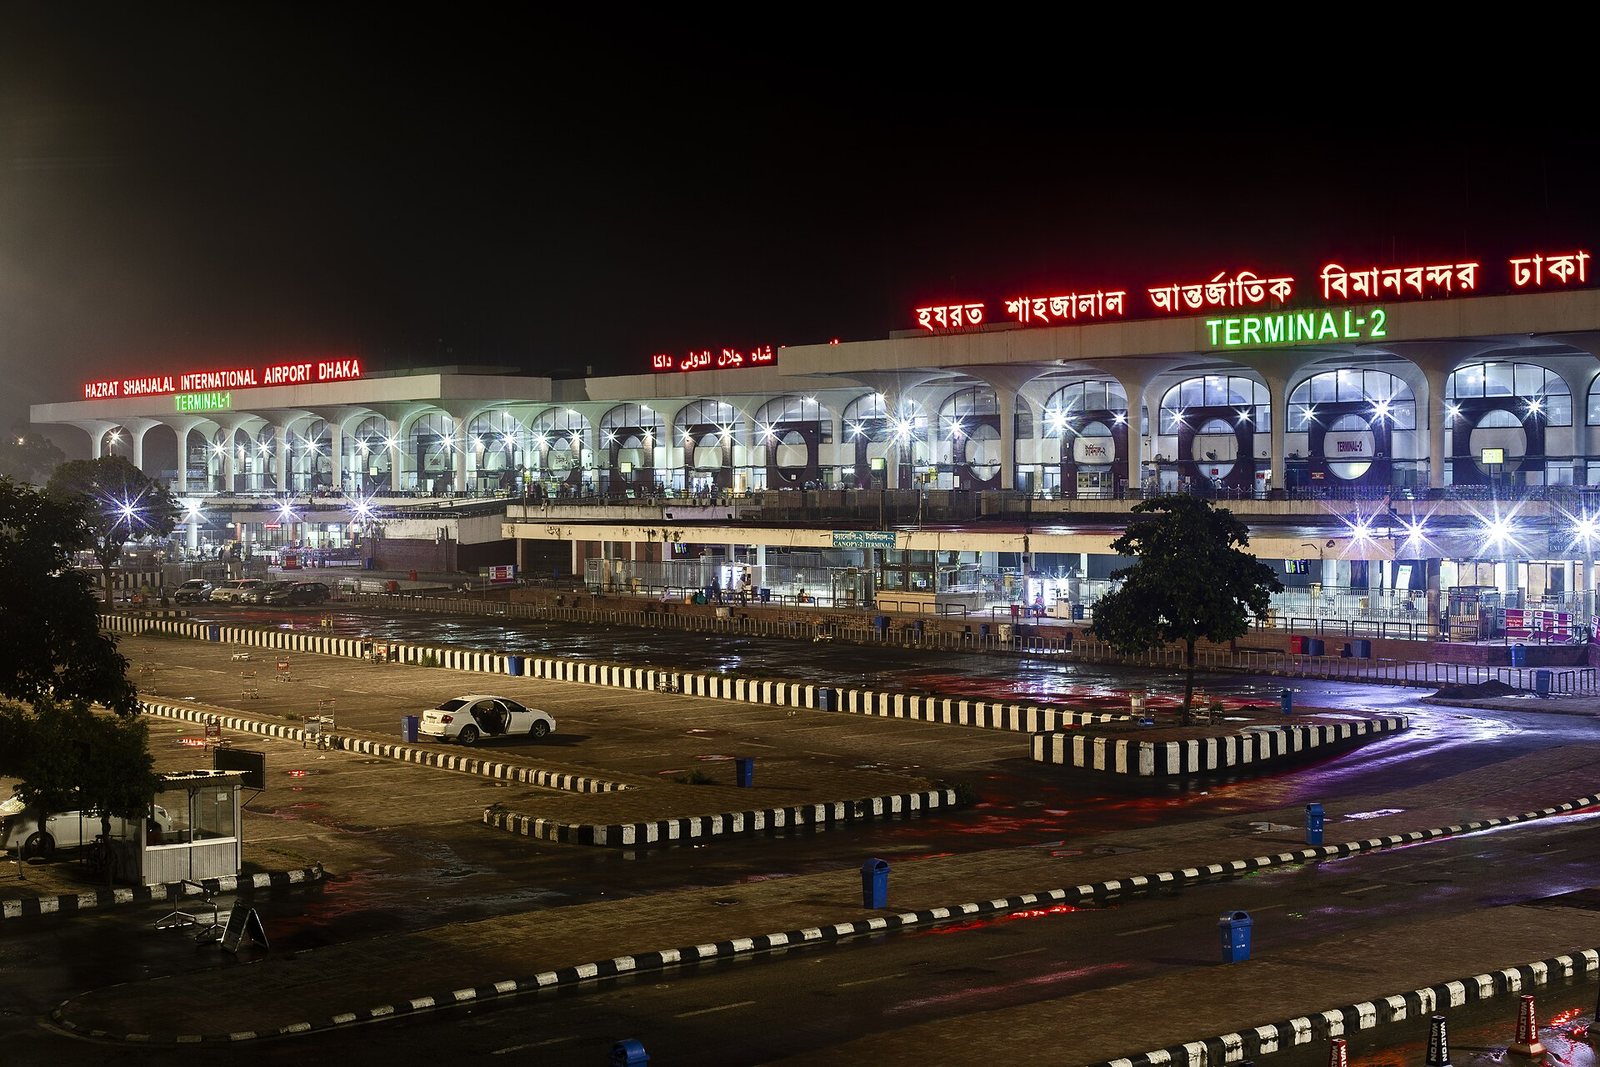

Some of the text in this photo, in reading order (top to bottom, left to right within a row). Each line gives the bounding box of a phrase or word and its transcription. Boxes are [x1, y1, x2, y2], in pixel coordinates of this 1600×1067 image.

[916, 250, 1590, 331] হযরত শাহজালাল আন্তর্জাতিক বিমানবন্দর ঢাকা
[1206, 309, 1387, 345] TERMINAL-2
[85, 360, 360, 398] HAZRAT SHAHJALAL INTERNATIONAL AIRPORT DHAKA
[175, 392, 231, 411] TERMINAL-1
[1337, 441, 1363, 452] TERMINAL-2
[1519, 1001, 1528, 1040] WALTON
[1529, 1000, 1537, 1040] WALTON
[1430, 1022, 1439, 1062] WALTON
[1440, 1021, 1448, 1062] WALTON
